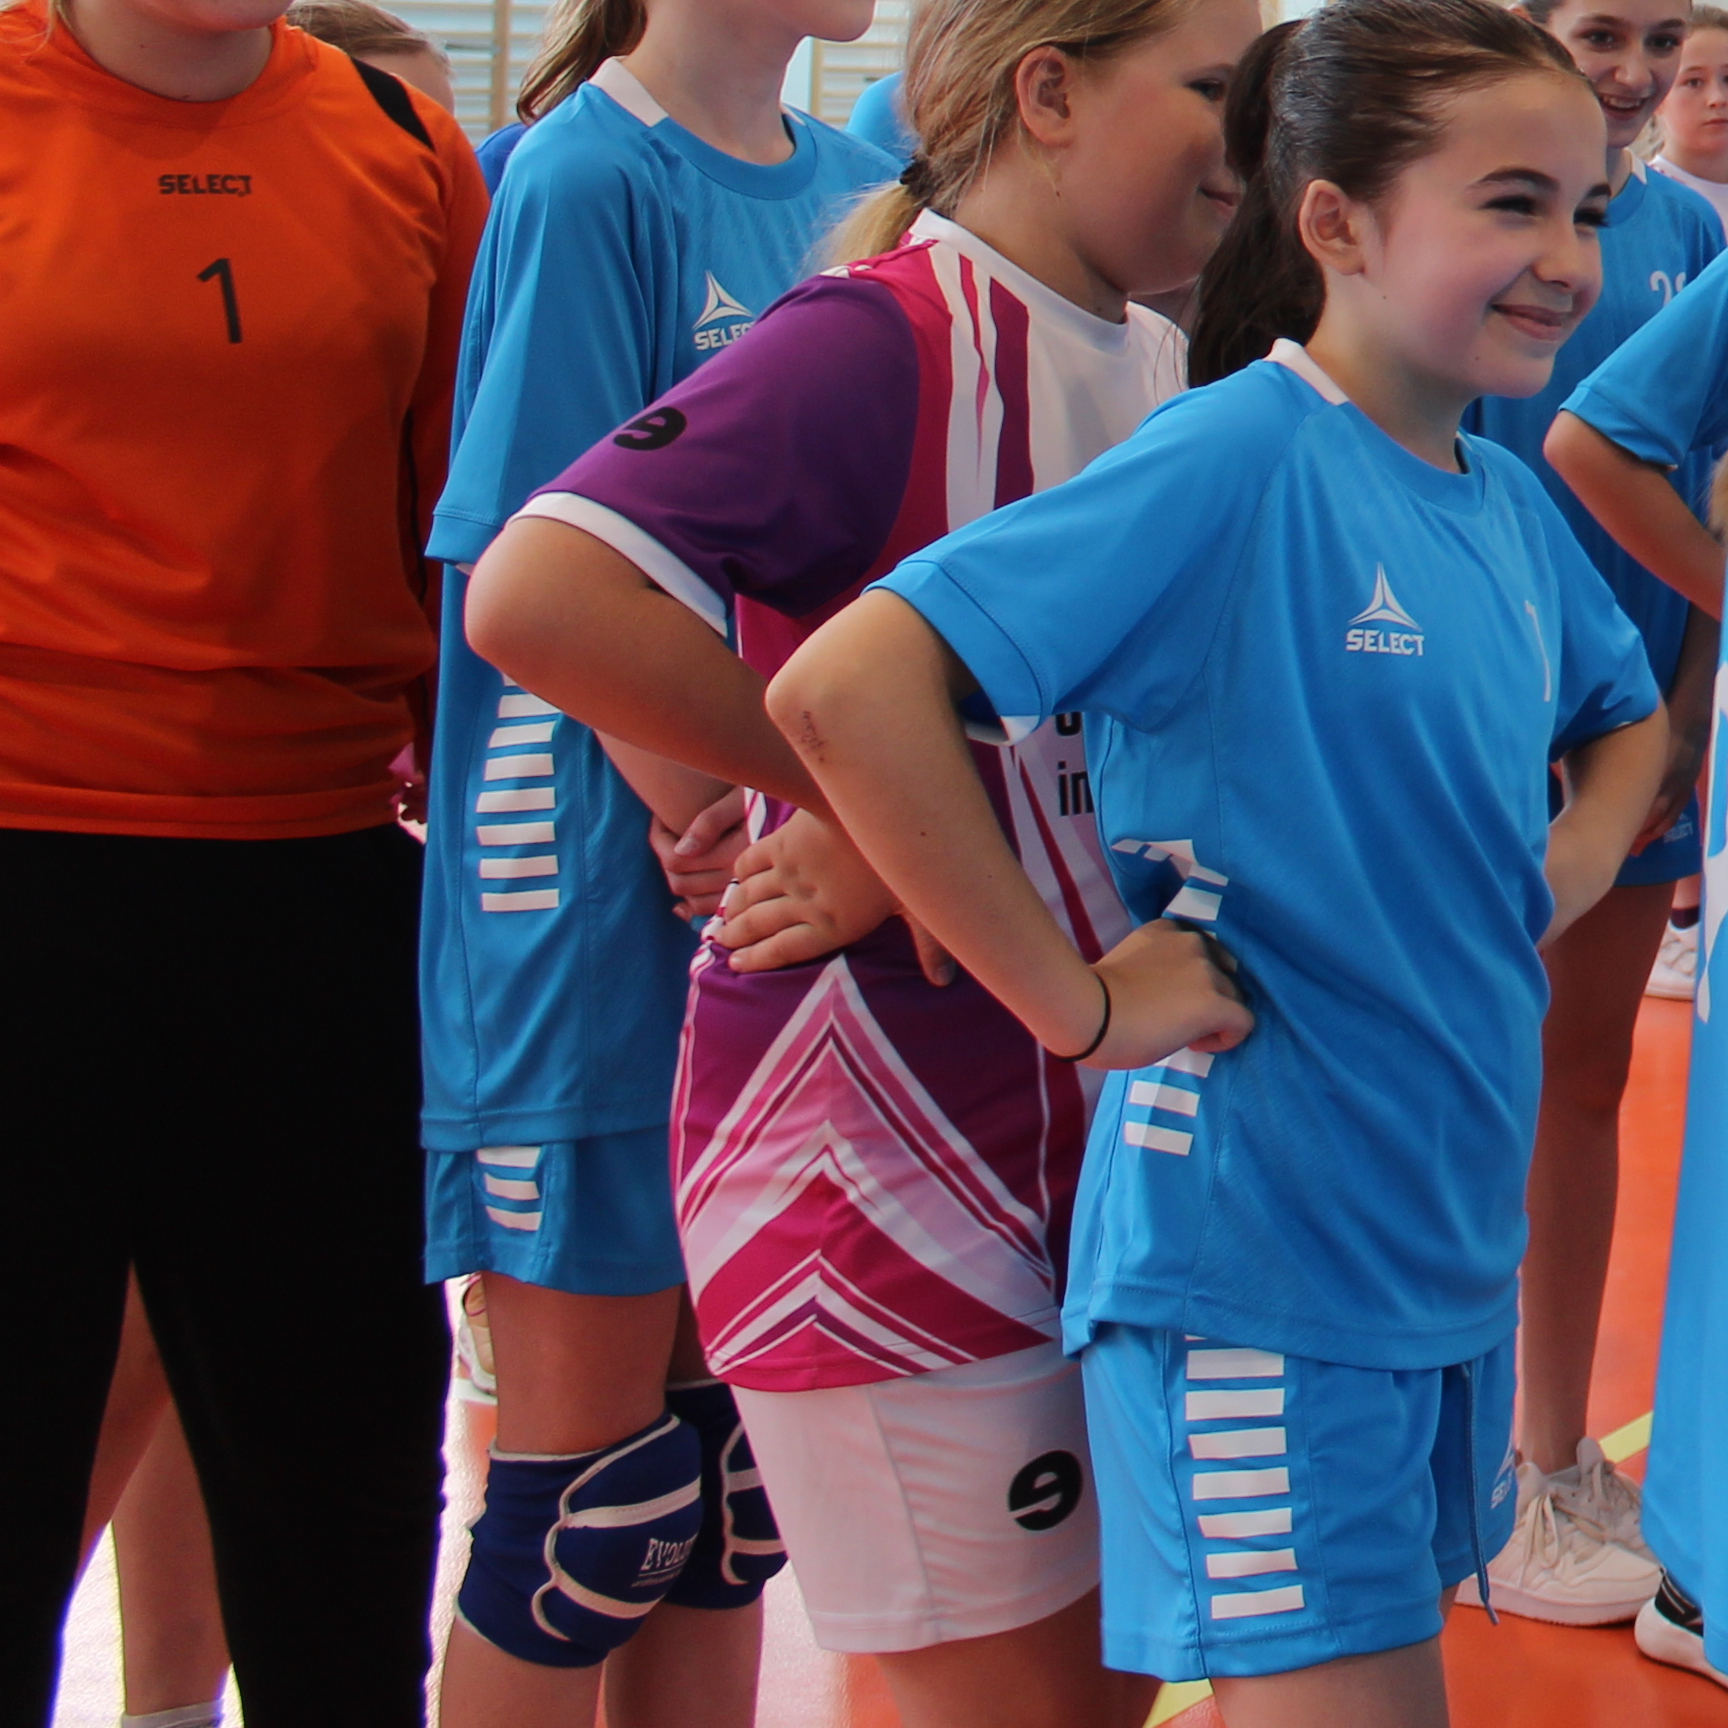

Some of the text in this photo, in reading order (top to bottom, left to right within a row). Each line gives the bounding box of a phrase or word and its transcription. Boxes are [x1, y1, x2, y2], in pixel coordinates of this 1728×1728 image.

[158, 174, 253, 195] SELECT
[197, 258, 242, 344] 1
[1346, 628, 1425, 657] SELECT
